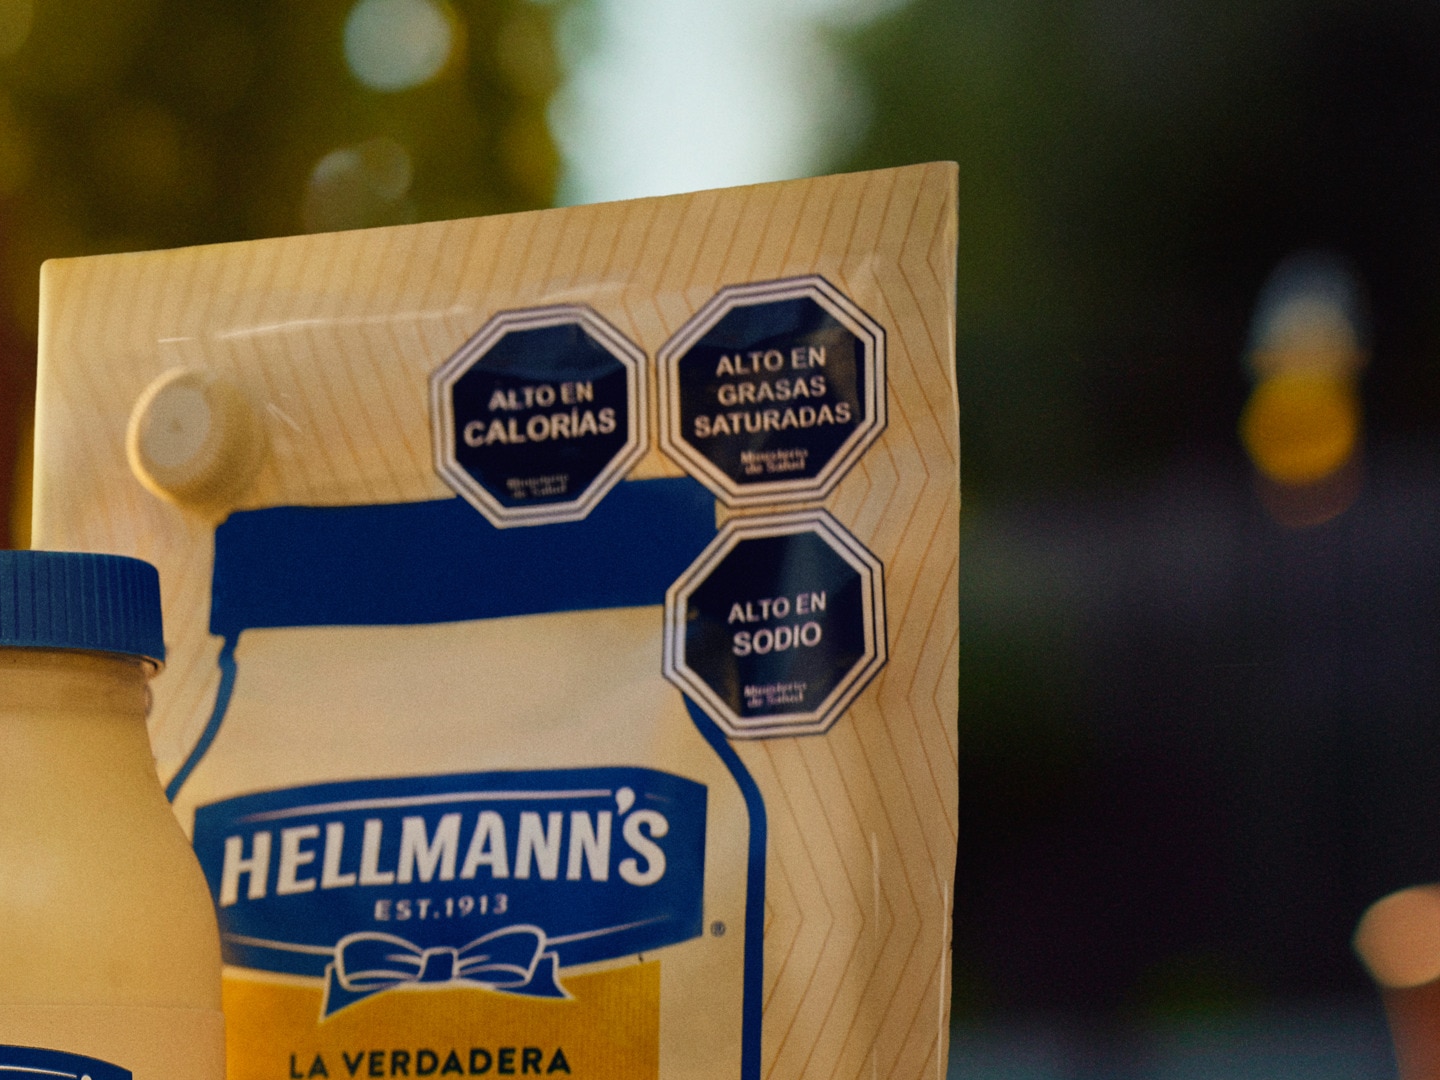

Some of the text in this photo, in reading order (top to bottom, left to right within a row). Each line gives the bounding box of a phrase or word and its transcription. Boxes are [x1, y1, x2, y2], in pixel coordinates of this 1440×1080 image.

[716, 345, 827, 377] ALTO EN
[488, 380, 594, 412] ALTO EN
[717, 374, 827, 407] GRASAS
[463, 406, 617, 448] CALORÍAS
[694, 401, 852, 438] SATURADAS
[727, 590, 827, 625] ALTO EN
[732, 621, 822, 656] SODIO
[219, 786, 669, 908] HELLMANN'S
[374, 893, 509, 922] EST.1913
[289, 1047, 572, 1080] LA VERDADERA
